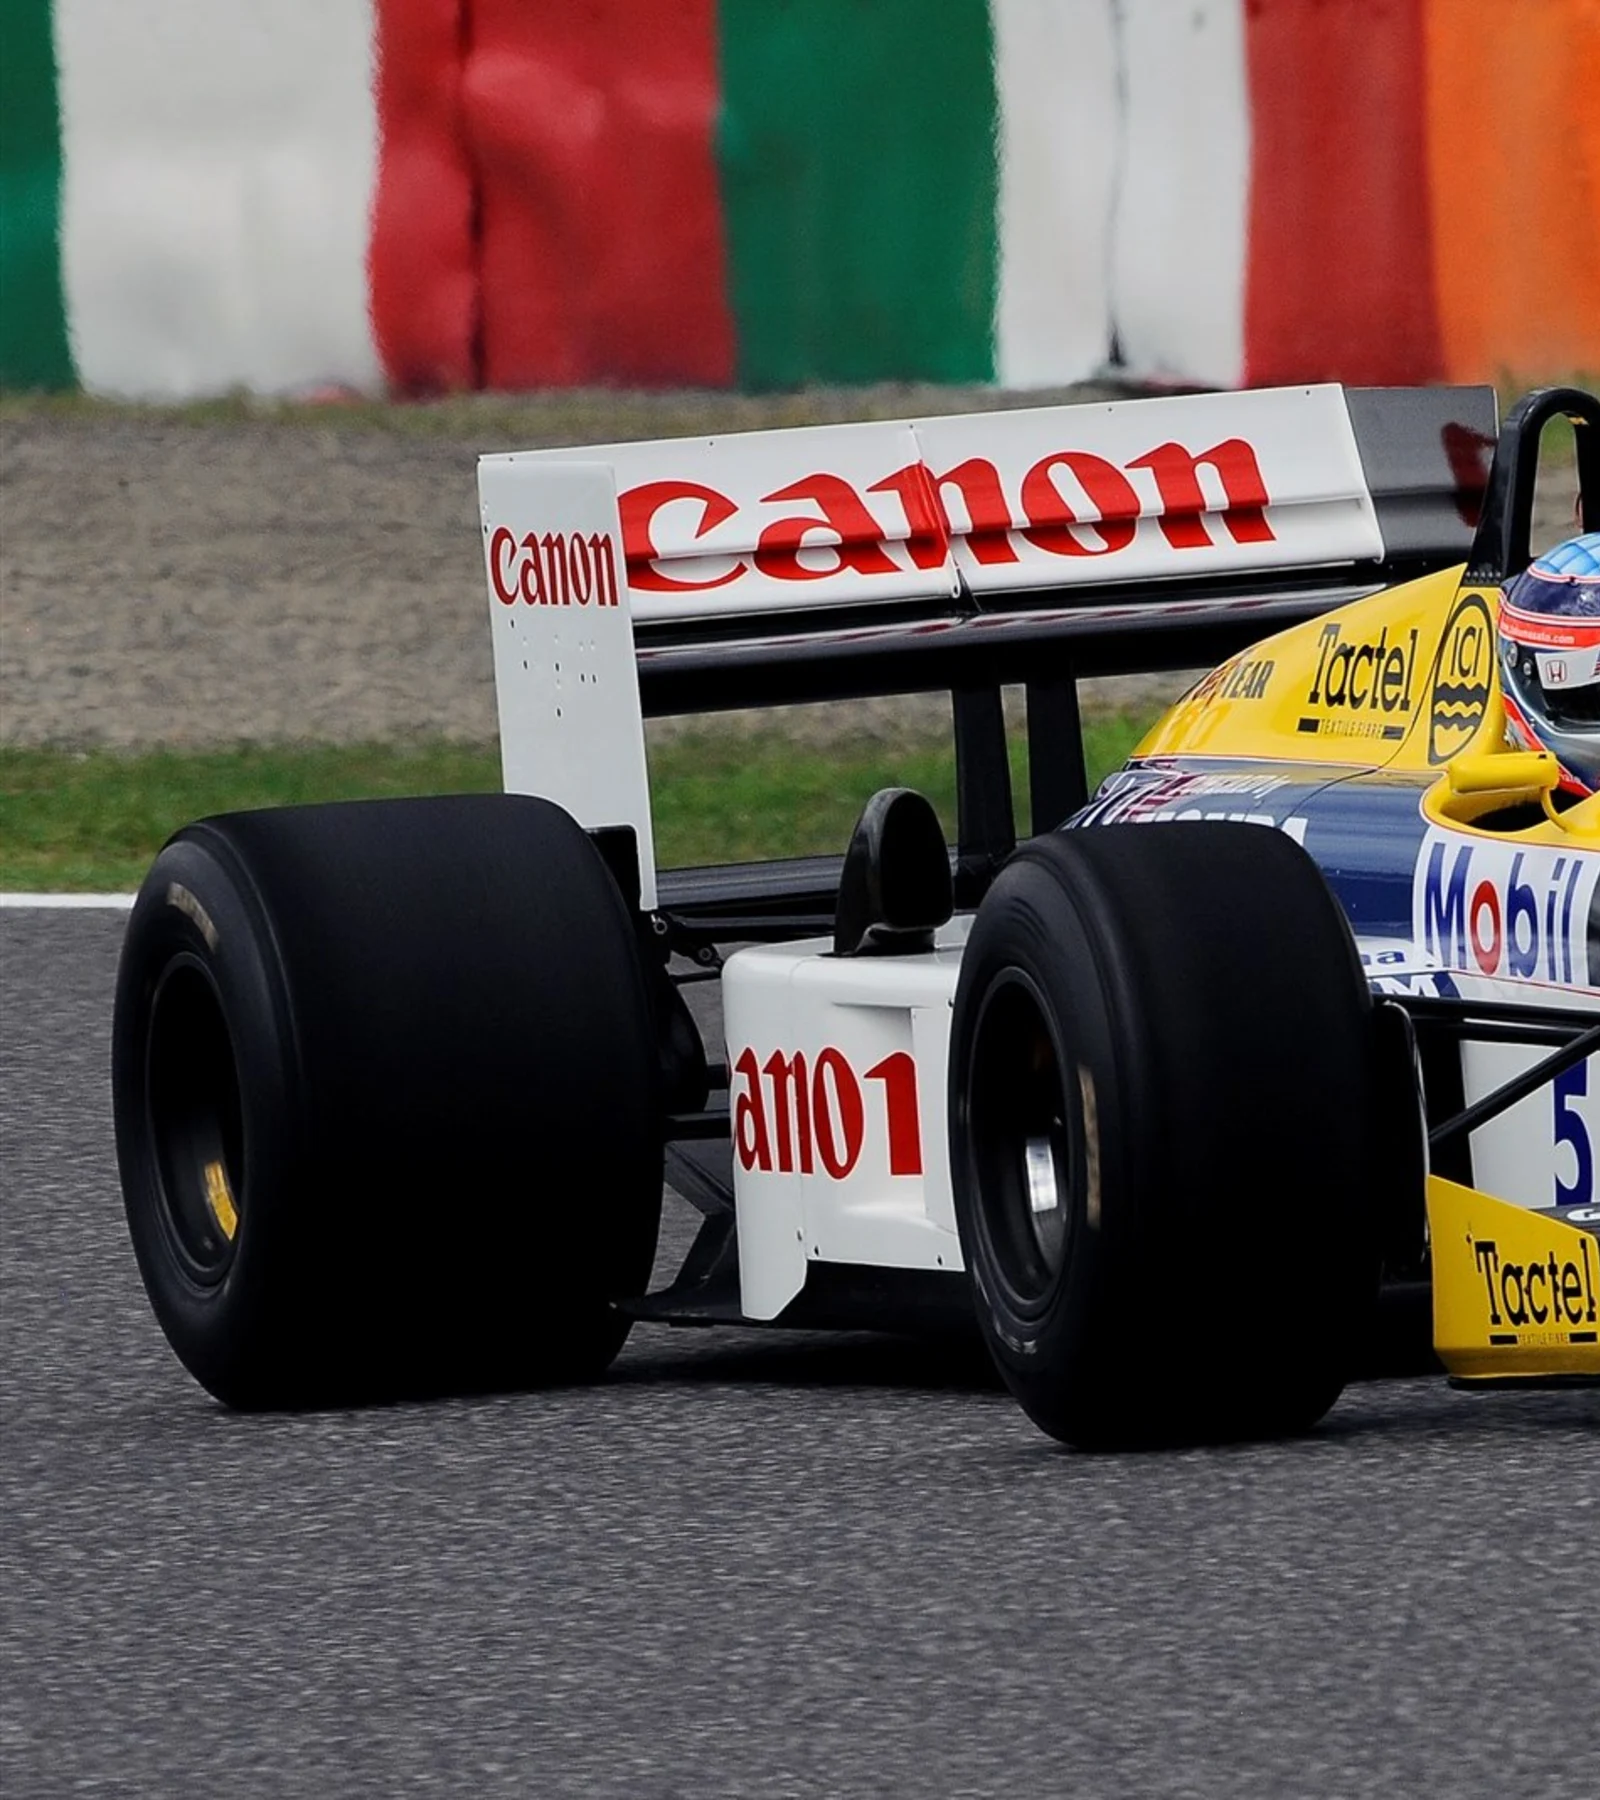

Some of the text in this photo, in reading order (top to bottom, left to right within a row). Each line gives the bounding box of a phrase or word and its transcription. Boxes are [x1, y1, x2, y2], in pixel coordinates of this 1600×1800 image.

[616, 437, 1277, 593] Canon
[490, 526, 619, 607] Canon
[1308, 622, 1419, 713] Tactel
[1449, 625, 1483, 678] ICI
[1320, 718, 1356, 737] TEXTILE
[1423, 841, 1583, 984] Mobil
[1553, 1056, 1594, 1205] 5
[1474, 1238, 1597, 1327] Tactel
